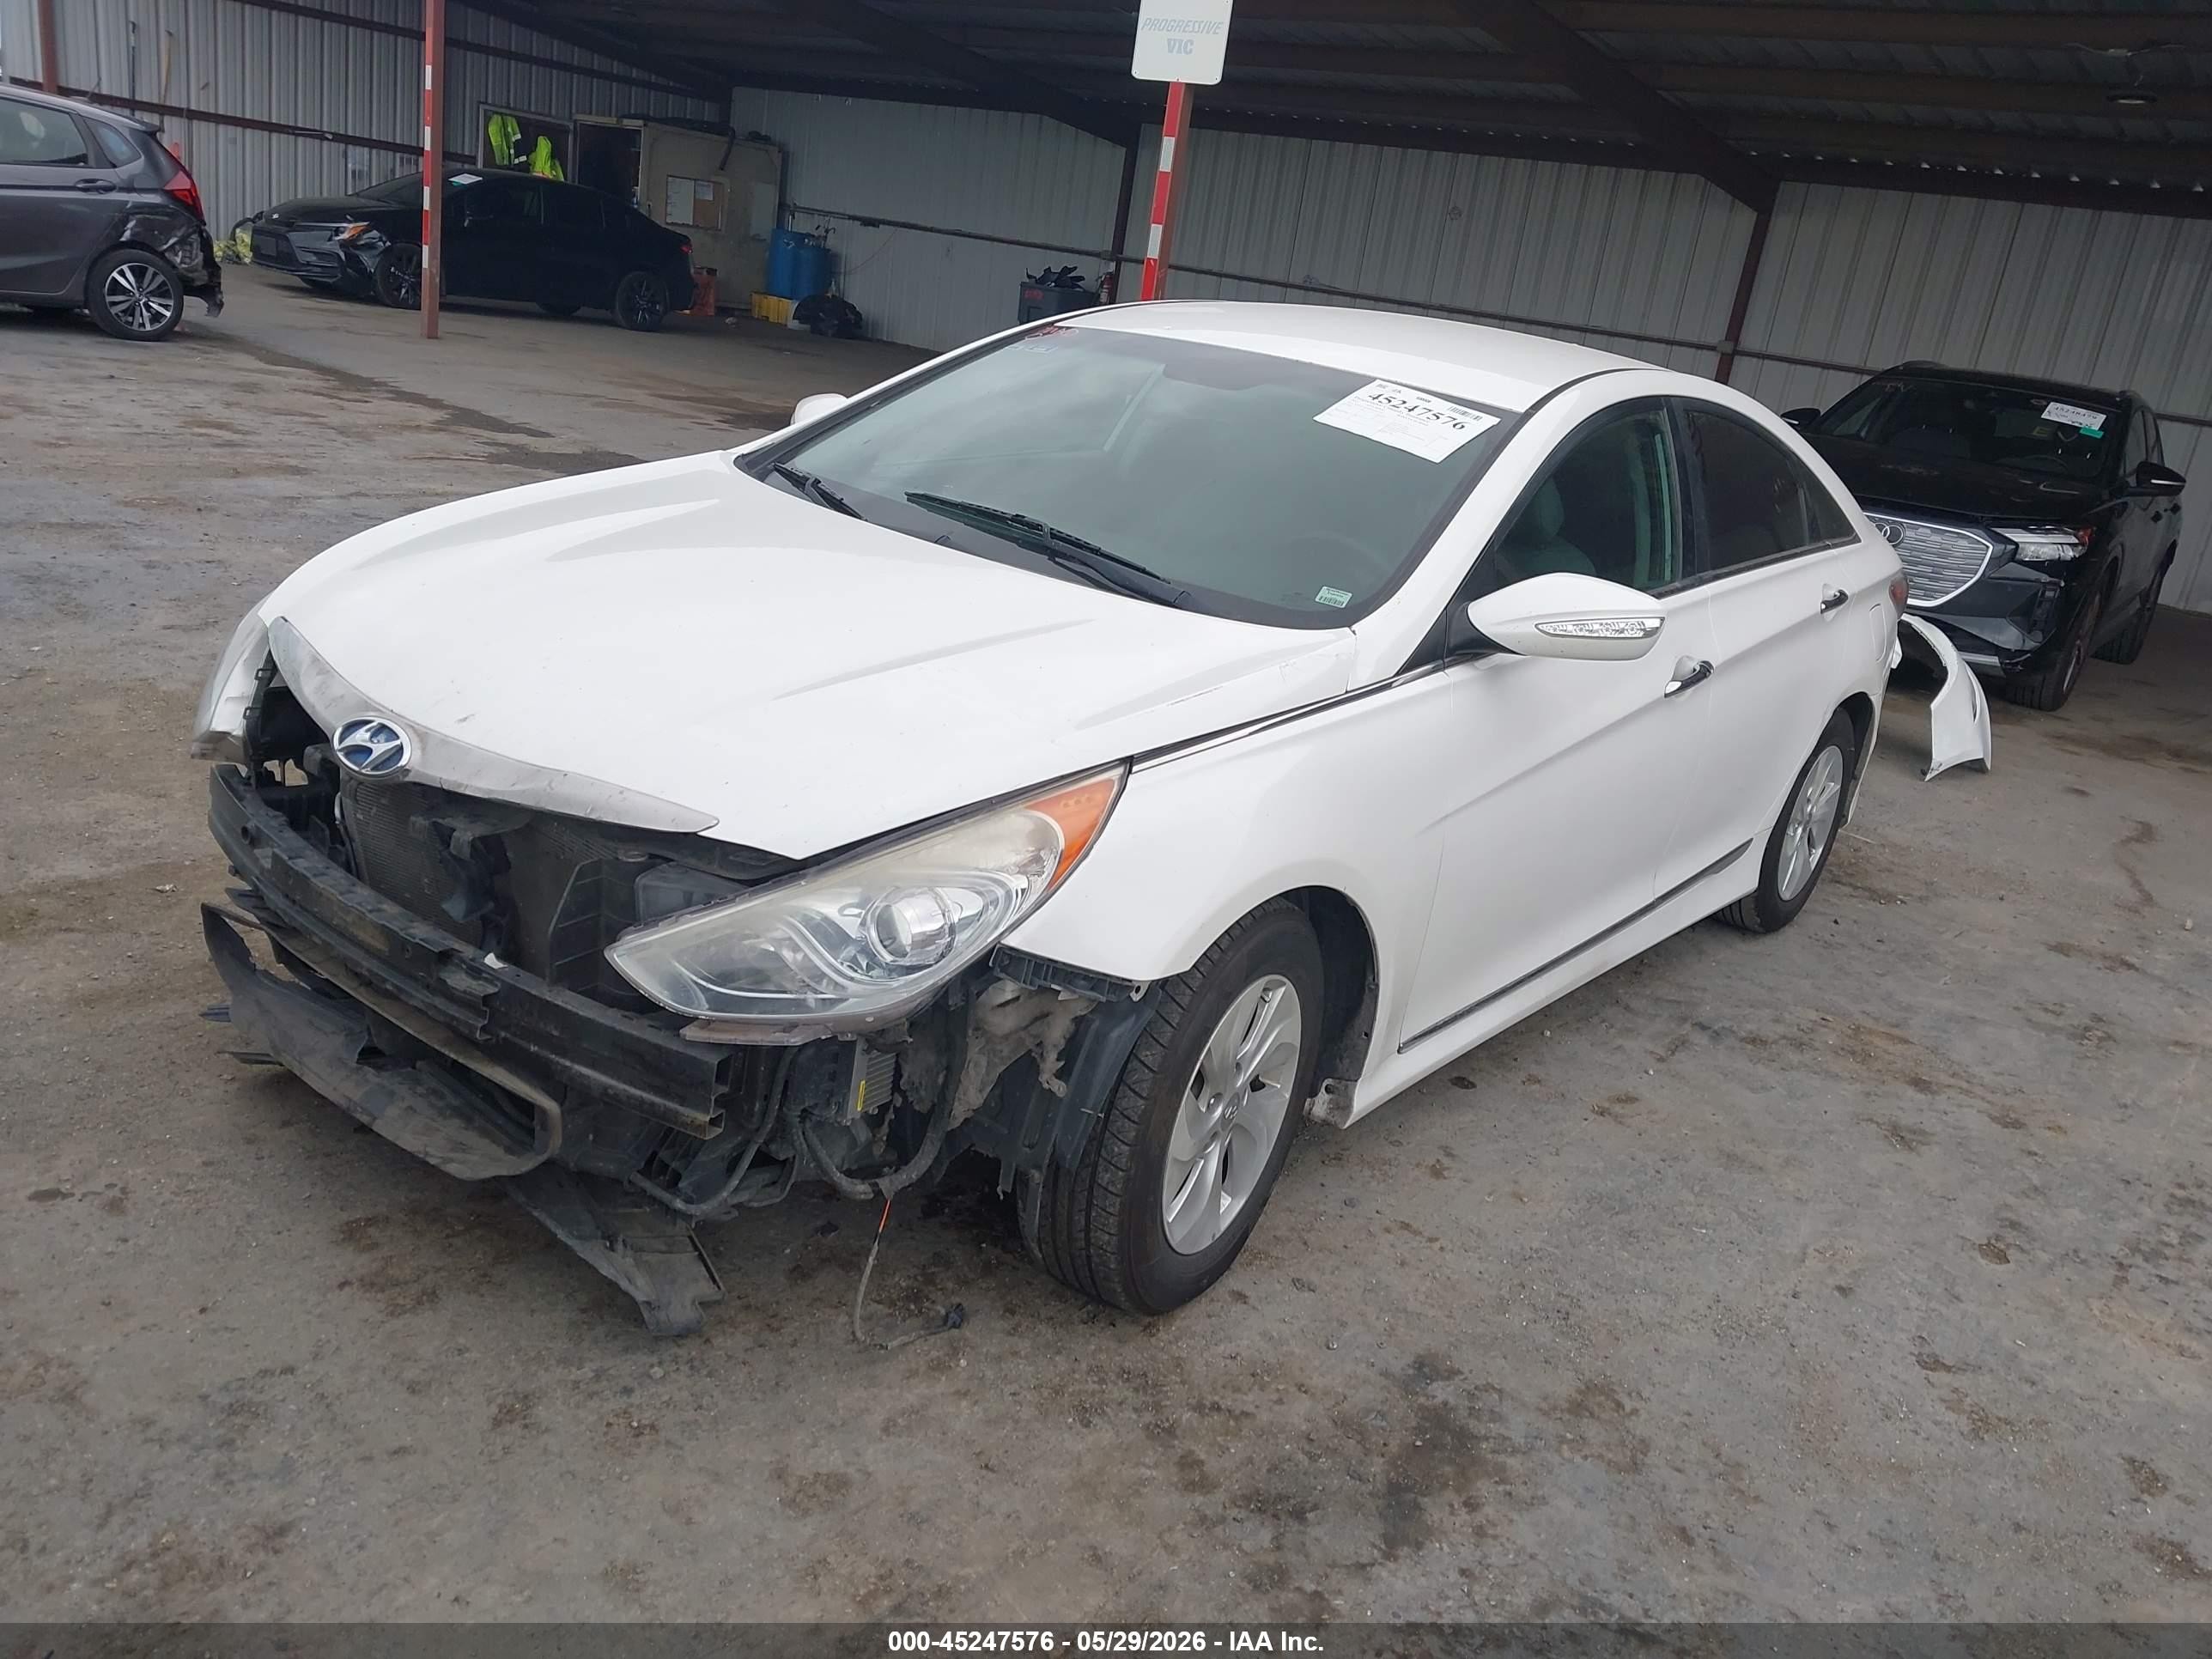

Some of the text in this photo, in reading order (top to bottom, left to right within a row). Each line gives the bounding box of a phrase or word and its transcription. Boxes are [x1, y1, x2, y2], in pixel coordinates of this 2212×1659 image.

[1140, 17, 1224, 35] PROGRESSIVE
[1167, 38, 1194, 55] VIC
[1368, 392, 1471, 430] 45247576
